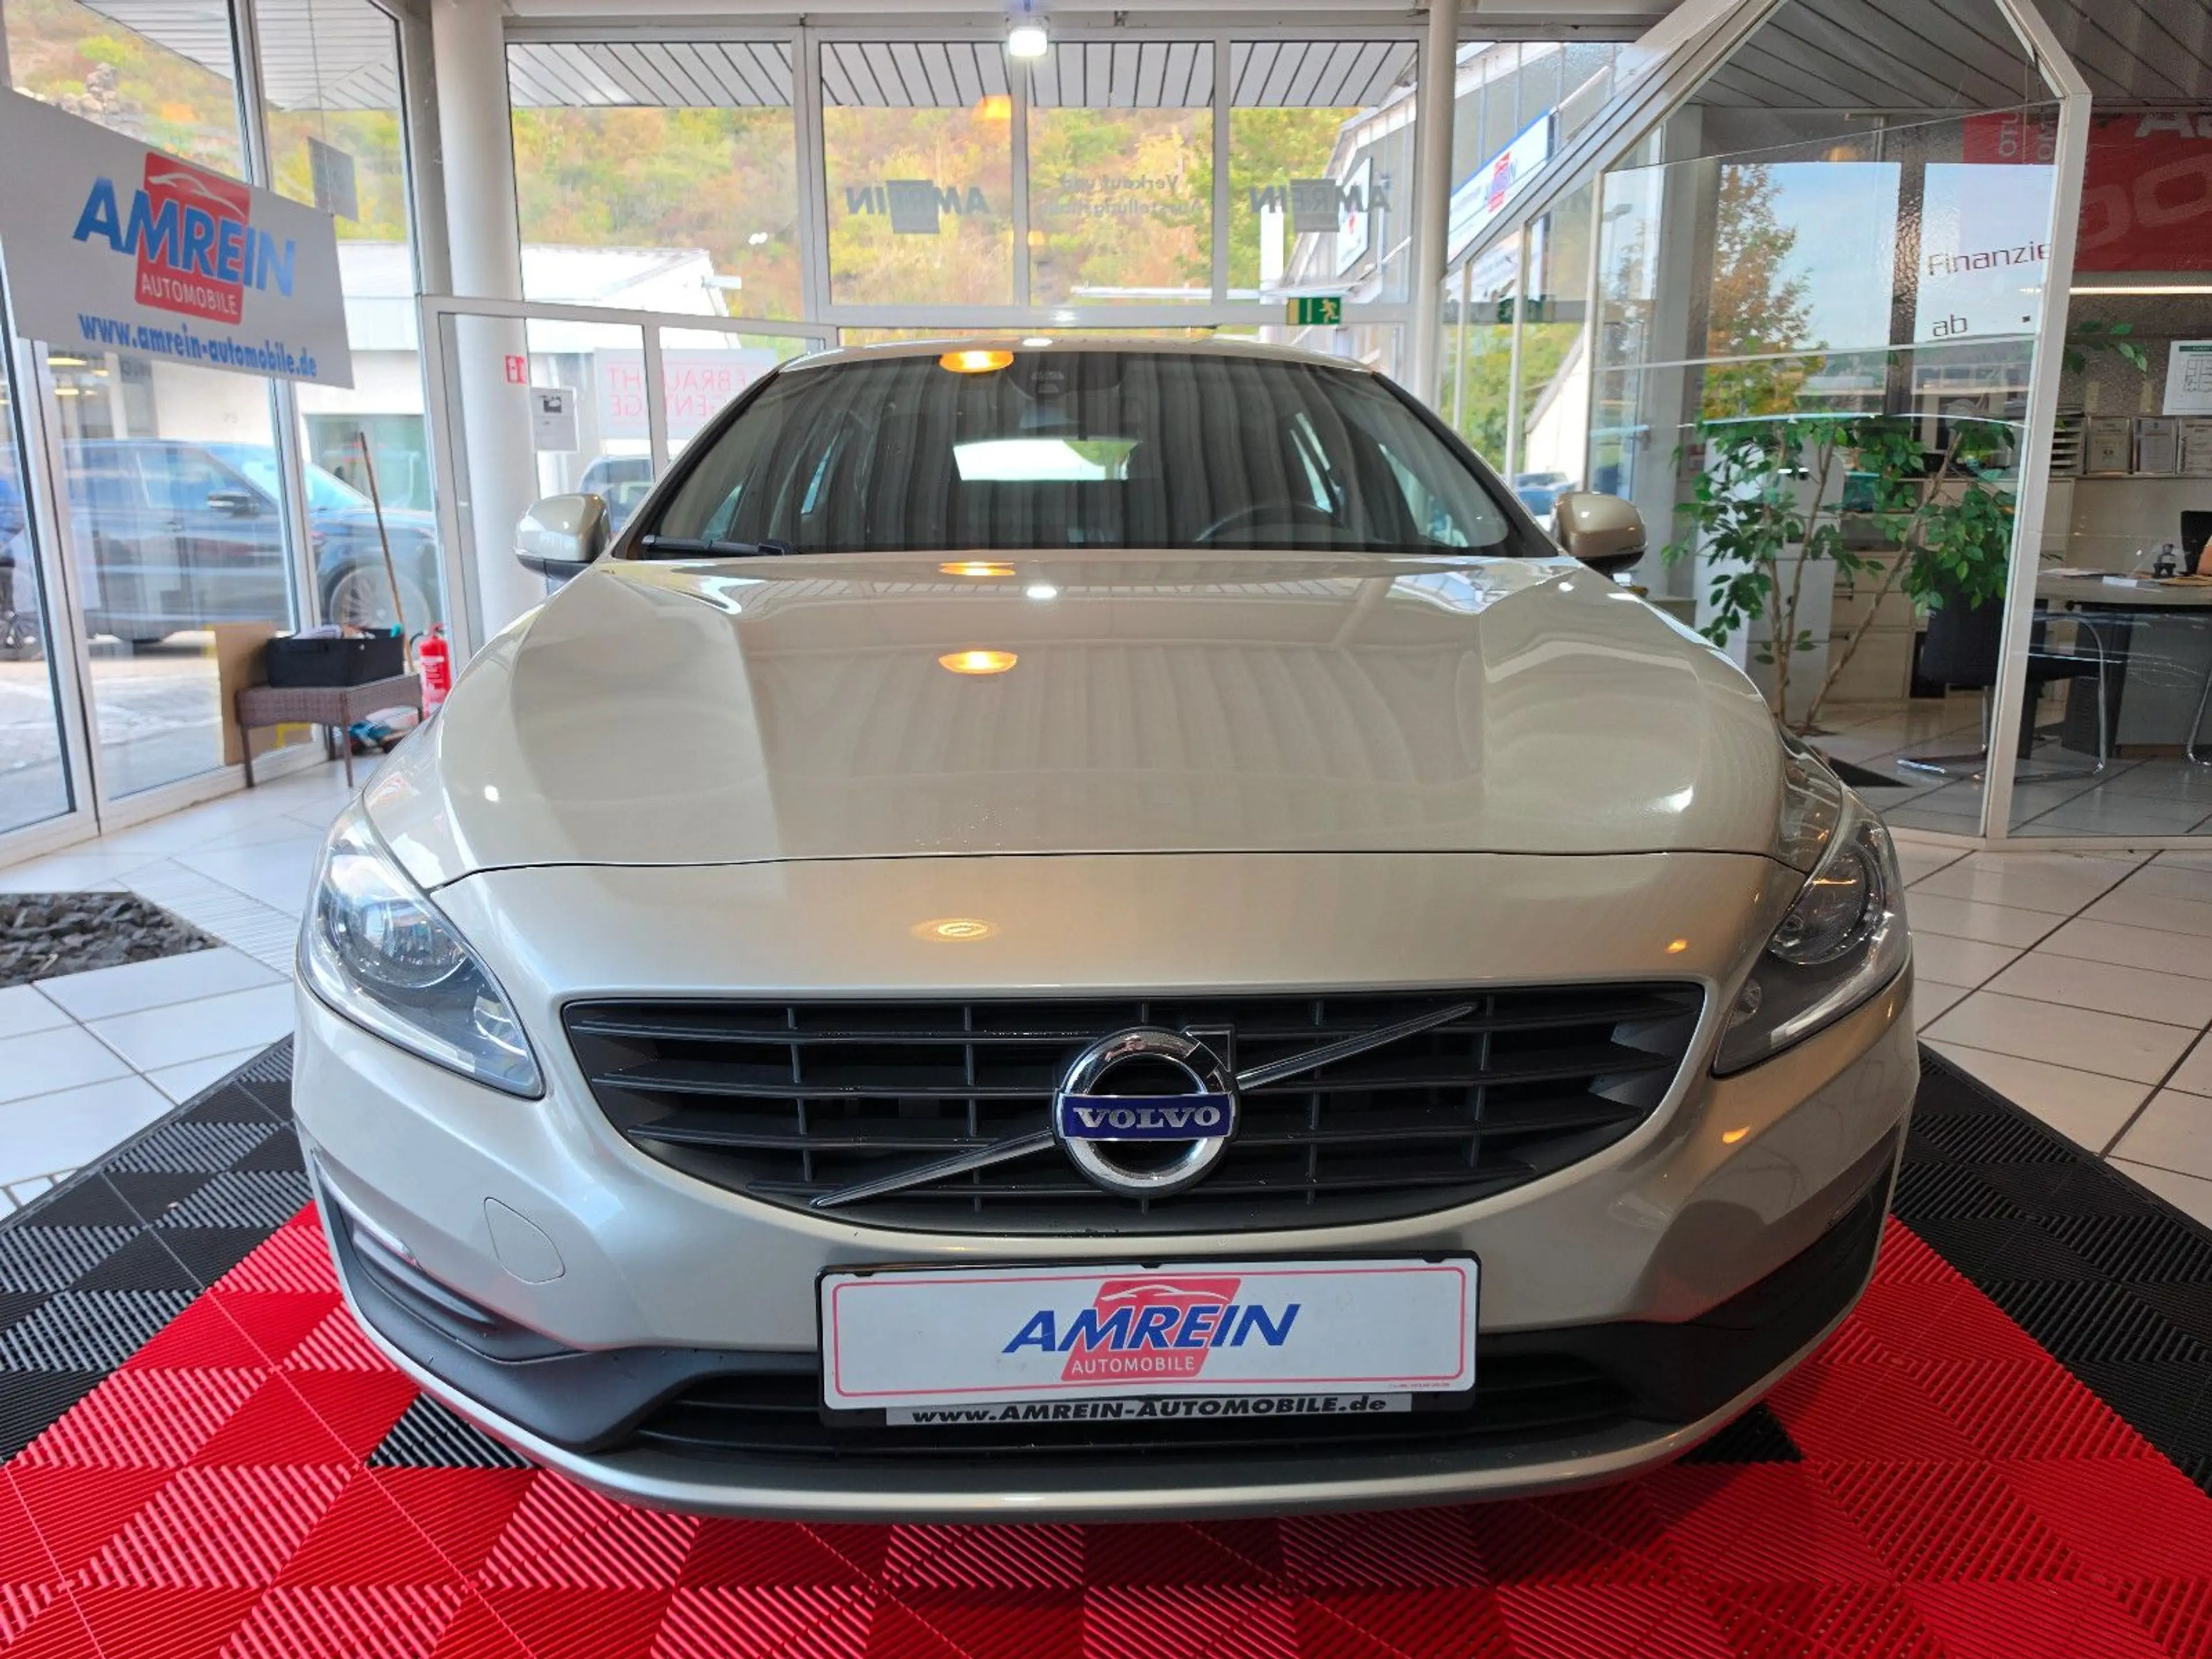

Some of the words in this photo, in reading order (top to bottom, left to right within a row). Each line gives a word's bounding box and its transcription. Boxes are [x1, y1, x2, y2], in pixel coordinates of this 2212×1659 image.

[73, 177, 296, 298] AMREIN
[142, 273, 238, 316] AUTOMOBILE
[1932, 314, 1968, 337] ab
[78, 314, 317, 377] www.amrein-automobile.de
[1073, 1106, 1221, 1129] VOLVO
[1001, 1304, 1301, 1354] AMREIN
[1070, 1356, 1196, 1375] AUTOMOBILE
[912, 1396, 1387, 1425] www.AMREIN-AUTOMOBILE.de
